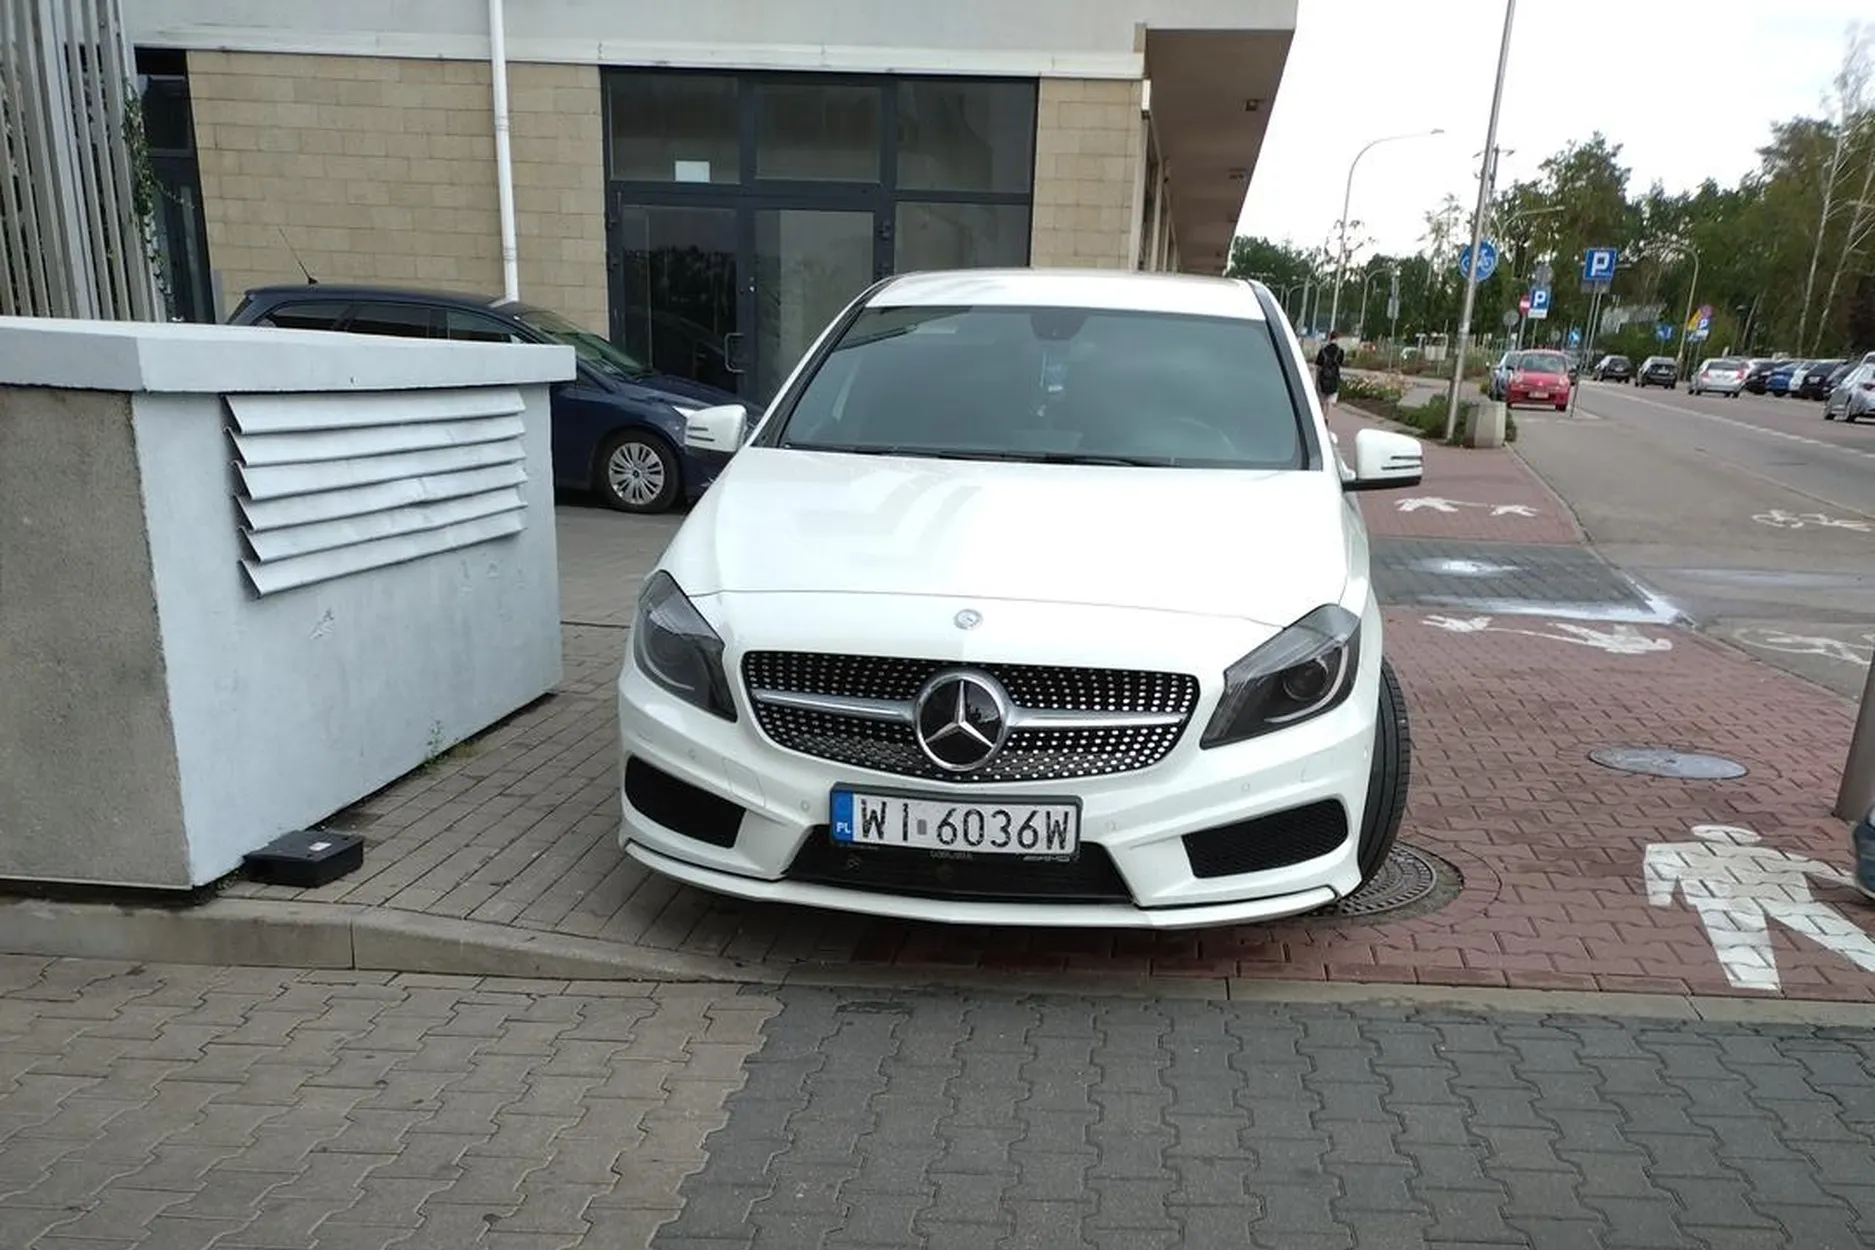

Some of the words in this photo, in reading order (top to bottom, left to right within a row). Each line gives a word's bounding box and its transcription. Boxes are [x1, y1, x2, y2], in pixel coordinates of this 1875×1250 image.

[1591, 252, 1610, 277] P
[1533, 291, 1546, 307] P
[836, 822, 851, 833] PL
[861, 798, 909, 842] WI
[936, 808, 1069, 850] 6036W
